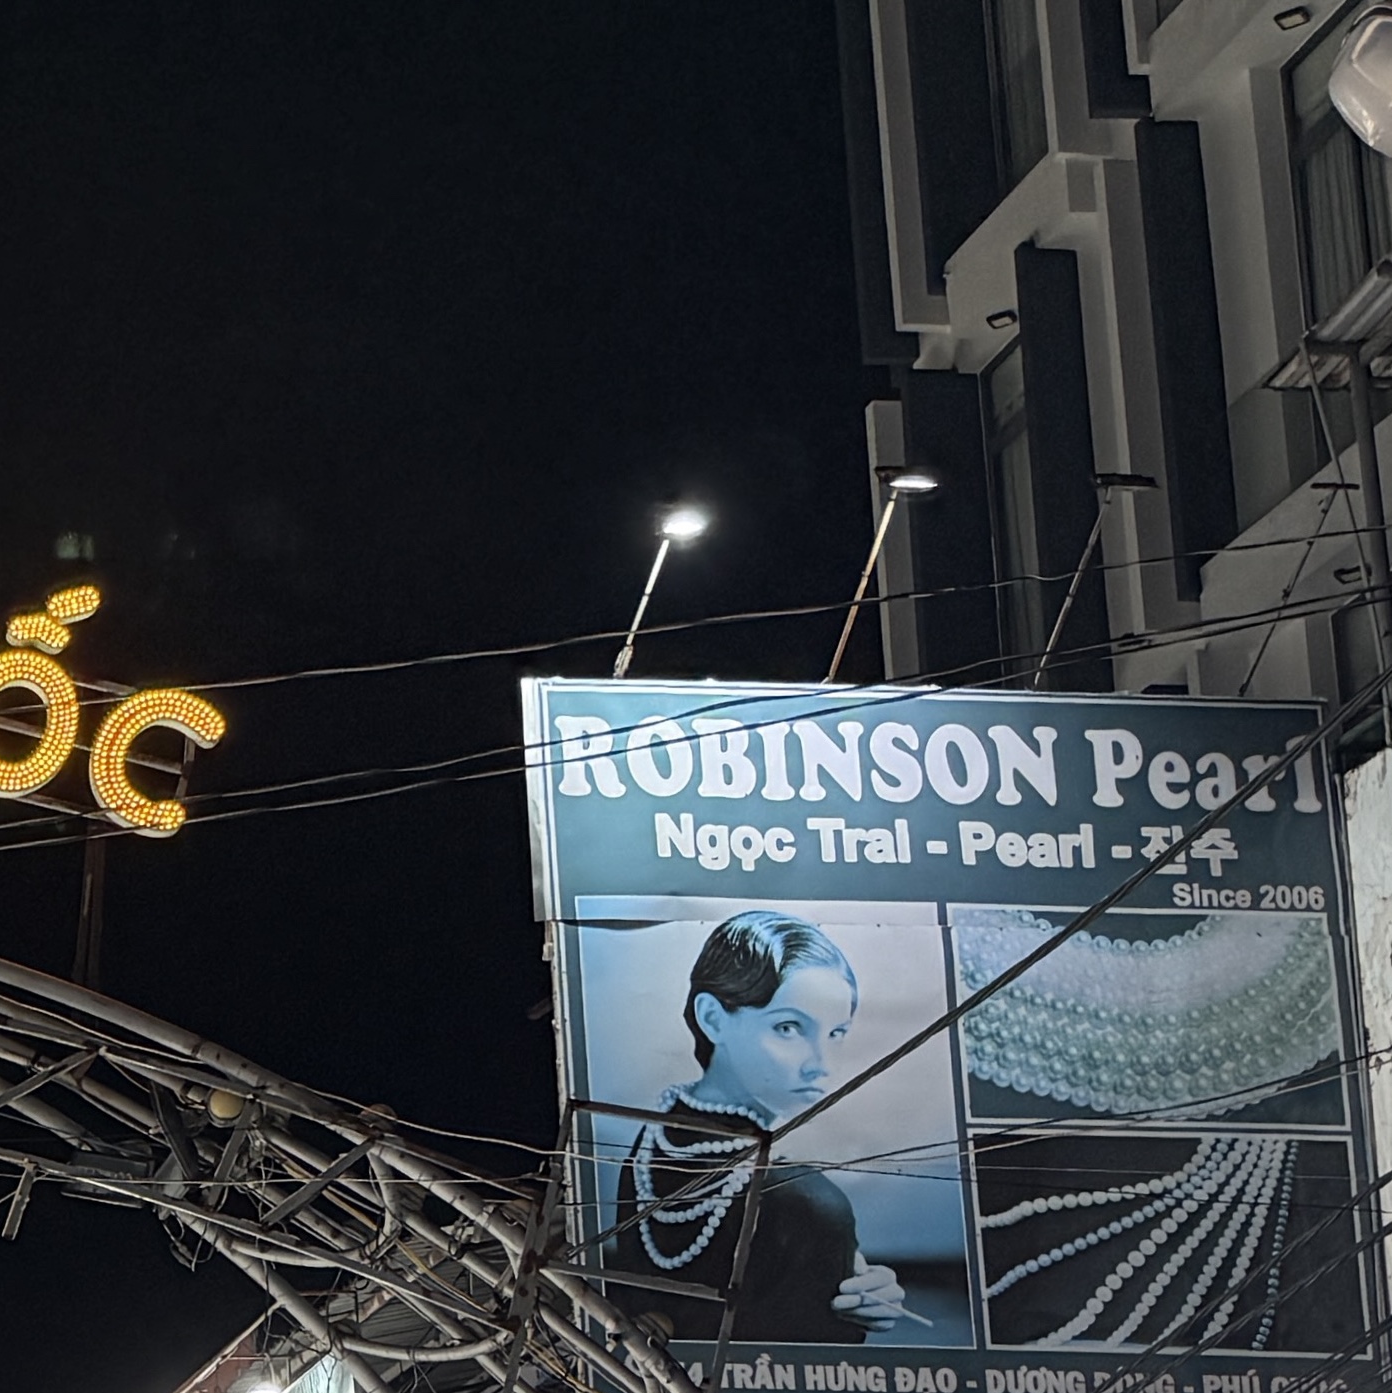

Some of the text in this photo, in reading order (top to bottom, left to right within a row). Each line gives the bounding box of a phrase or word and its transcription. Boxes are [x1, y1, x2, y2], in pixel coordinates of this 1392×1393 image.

[554, 714, 1324, 813] ROBINSON Pearl
[654, 812, 796, 872] Ngọc
[959, 820, 1096, 869] Pearl
[1258, 884, 1326, 912] 2006
[804, 1361, 888, 1392] HƯNG
